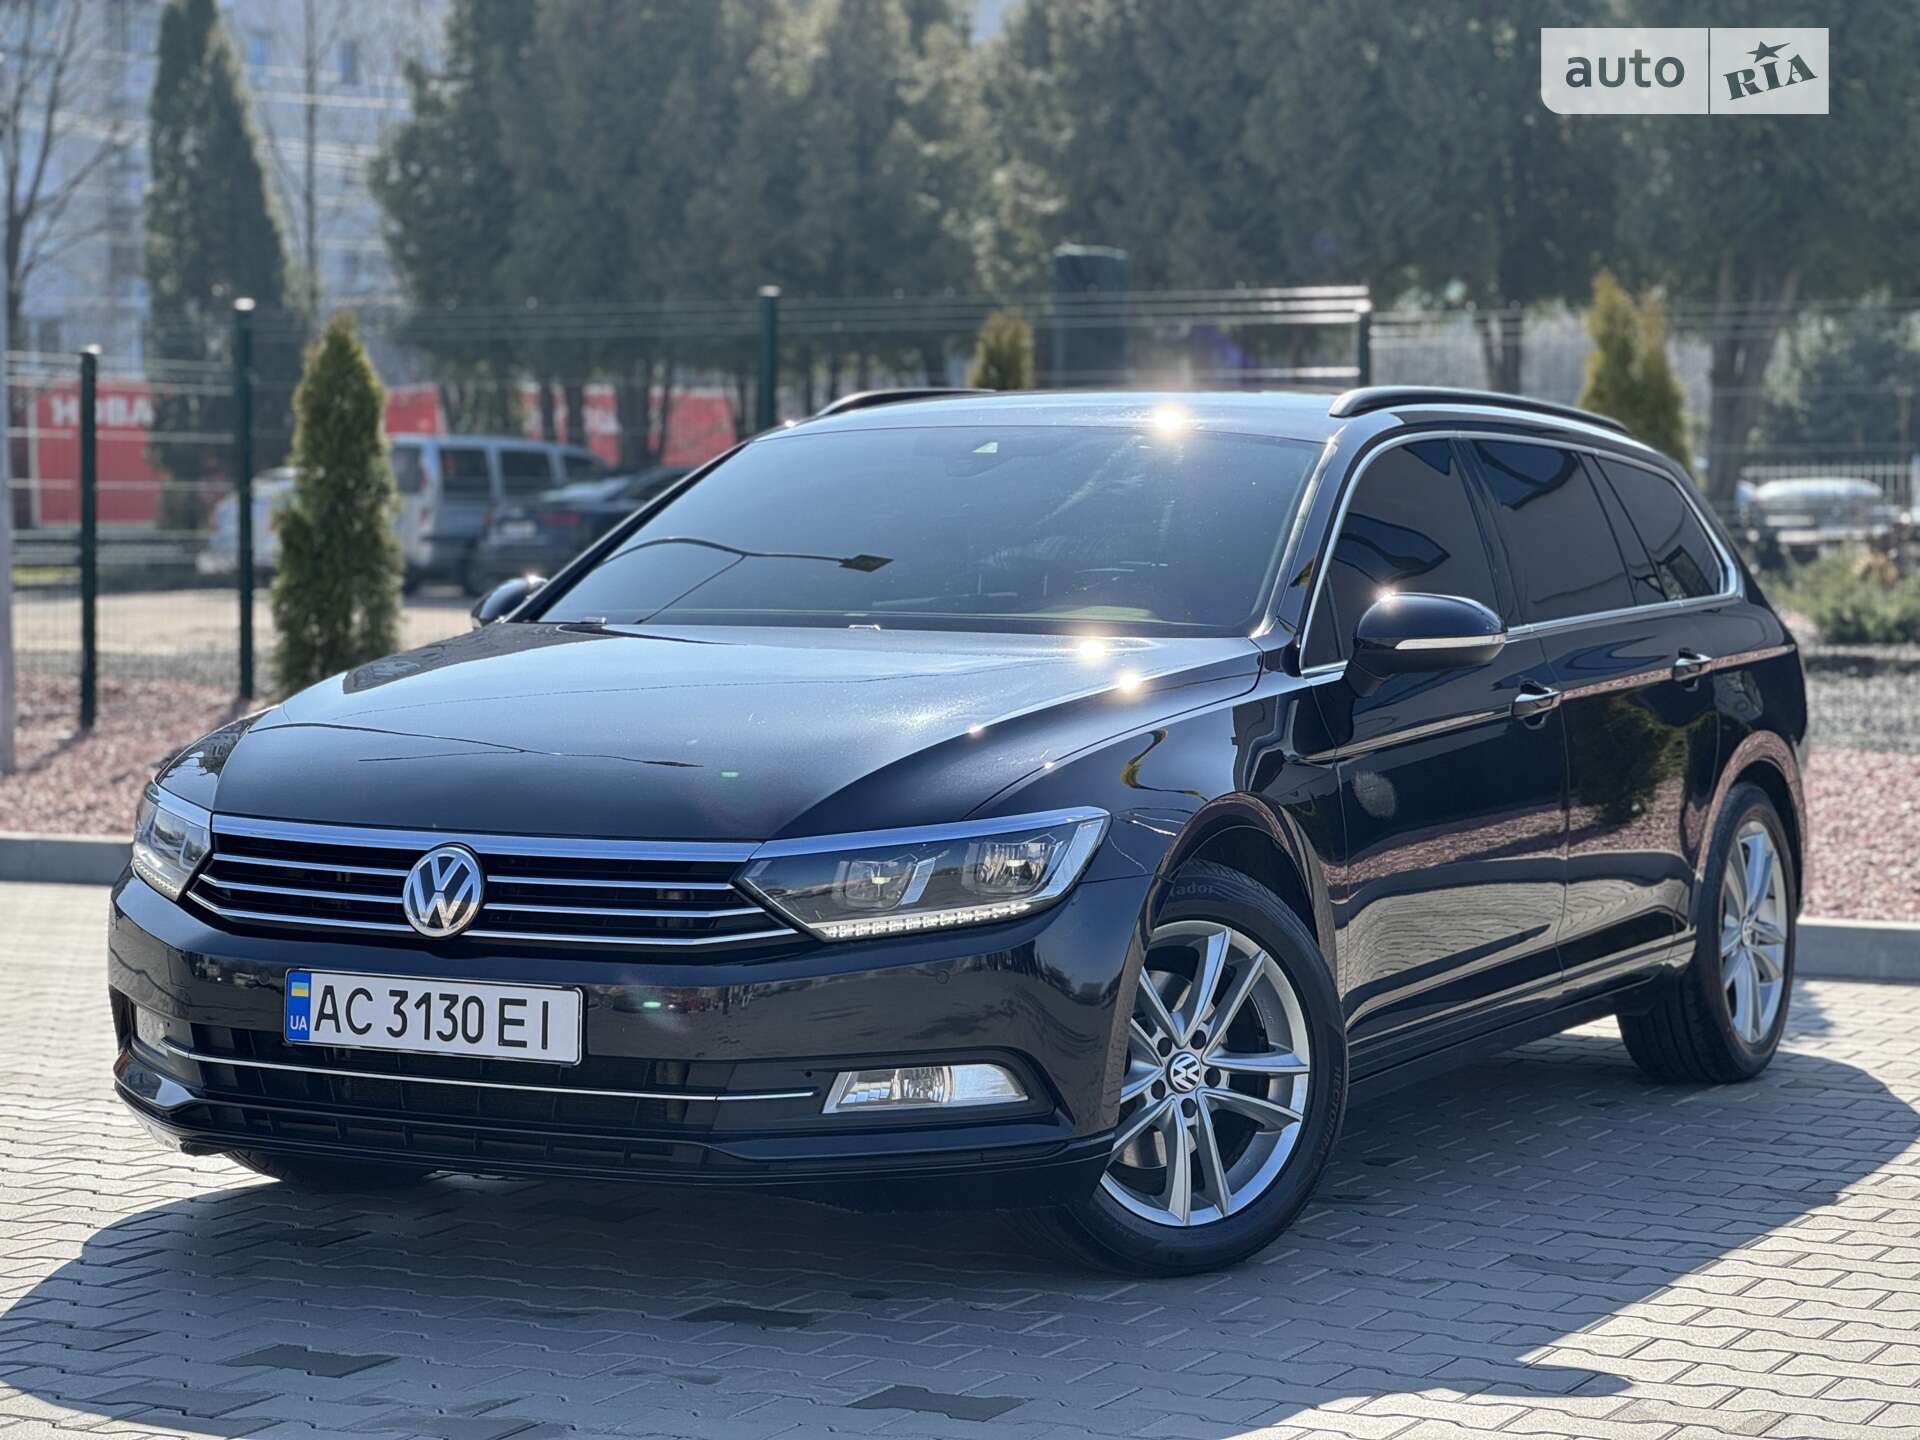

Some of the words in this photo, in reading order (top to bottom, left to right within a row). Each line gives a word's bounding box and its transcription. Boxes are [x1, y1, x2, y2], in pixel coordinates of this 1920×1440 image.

[289, 1014, 308, 1032] UA
[314, 984, 373, 1035] AC
[386, 989, 485, 1044] 3130
[498, 997, 549, 1050] EI
